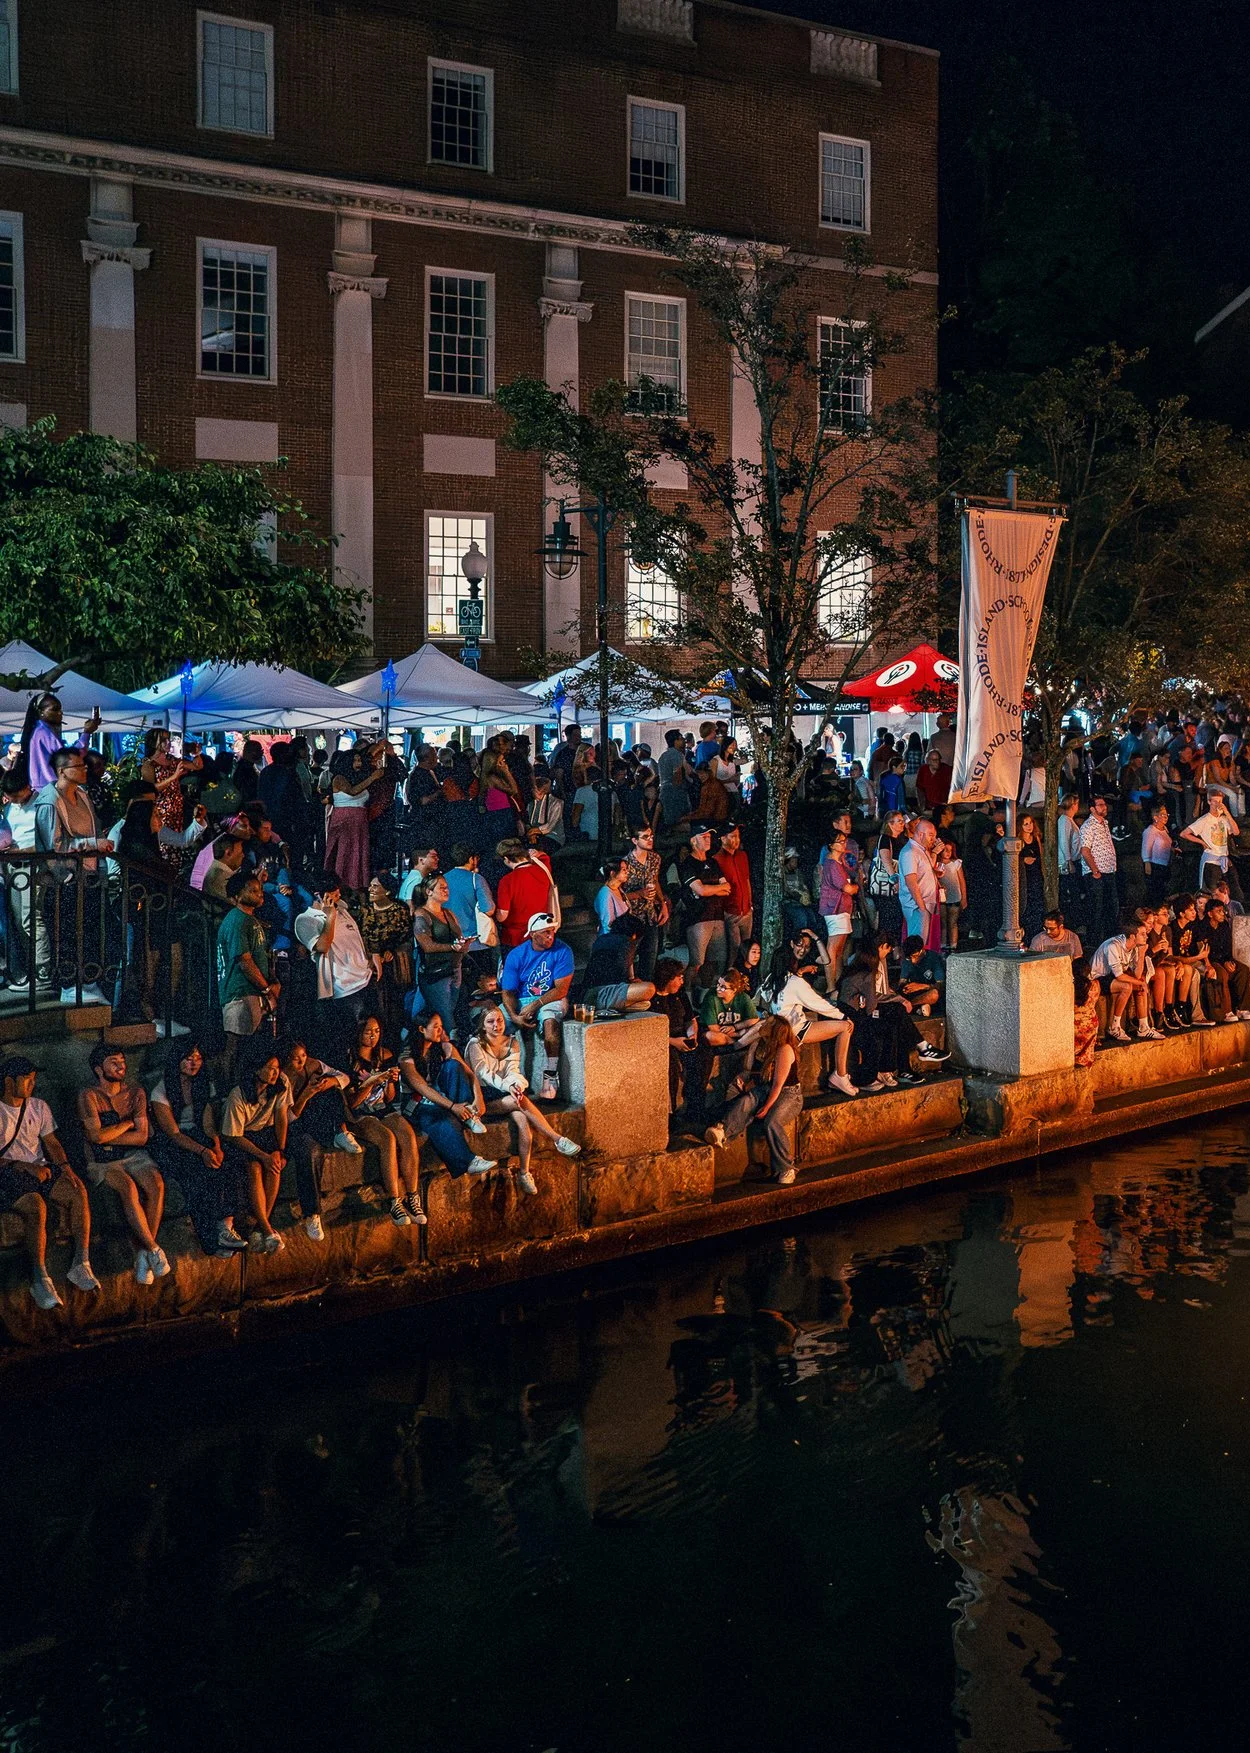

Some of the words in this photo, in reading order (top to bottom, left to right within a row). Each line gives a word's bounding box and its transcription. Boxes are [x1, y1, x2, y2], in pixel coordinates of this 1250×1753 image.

[975, 518, 1004, 576] RHODE
[1025, 528, 1055, 579] DESIGN
[977, 598, 1006, 649] ISLAND
[976, 653, 1005, 708] RHODE
[809, 702, 861, 711] MERANDISE
[971, 732, 1006, 782] ISLAND
